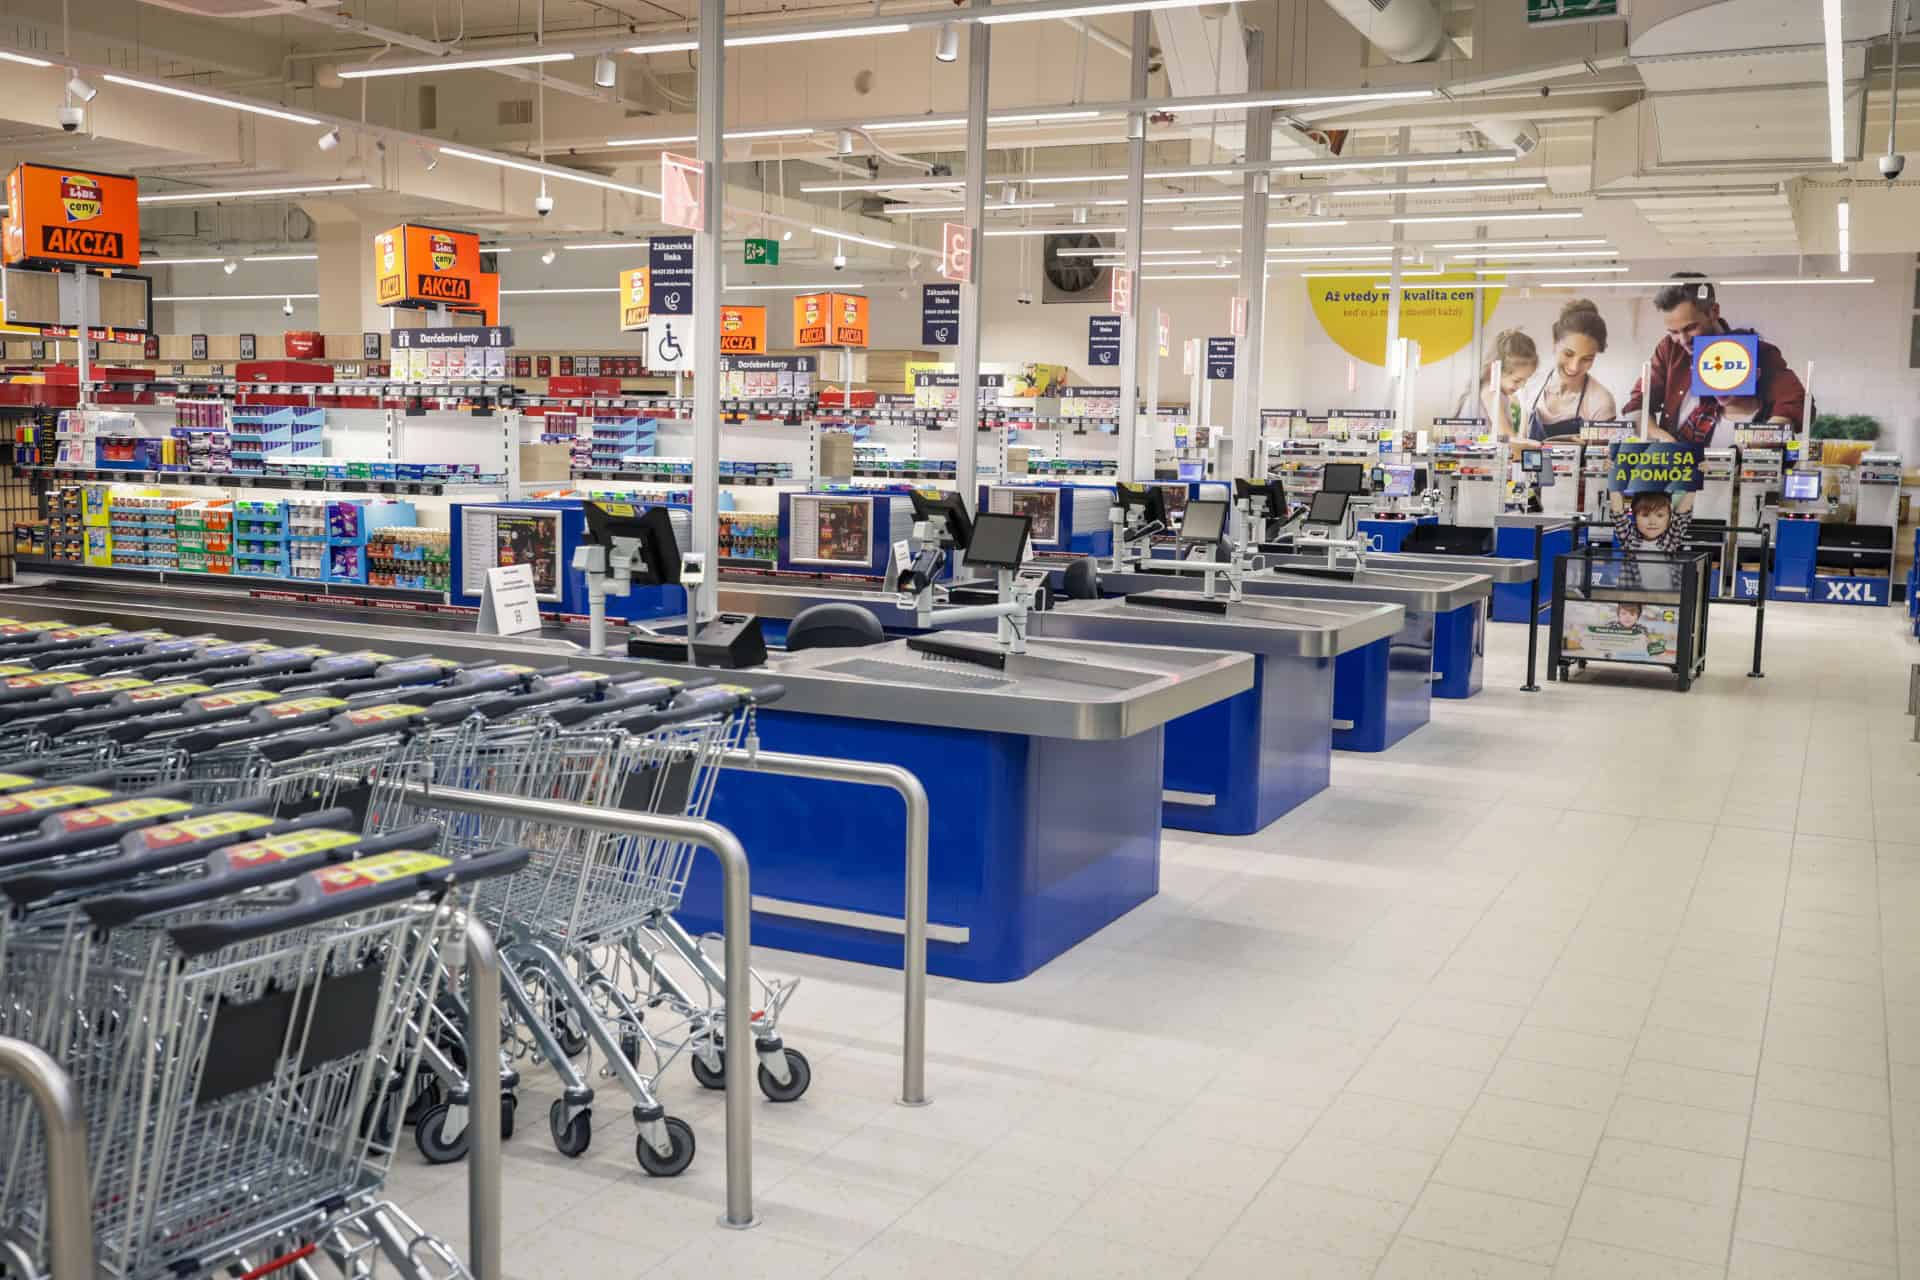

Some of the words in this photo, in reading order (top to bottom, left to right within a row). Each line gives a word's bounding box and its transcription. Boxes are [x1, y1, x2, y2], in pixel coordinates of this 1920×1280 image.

[69, 202, 95, 213] ceny
[47, 228, 119, 257] AKCIA
[436, 255, 452, 265] ceny
[664, 252, 682, 261] linka
[422, 277, 467, 298] AKCIA
[1325, 290, 1341, 302] Až
[1343, 291, 1379, 303] vtedy
[1404, 289, 1448, 301] kvalita
[459, 332, 480, 345] karty
[721, 336, 753, 350] KCIA
[1616, 451, 1670, 465] PODEĽ
[1672, 452, 1695, 465] SA
[1615, 469, 1627, 481] A
[1630, 466, 1694, 481] POMÔŽ
[1826, 582, 1878, 602] XXL
